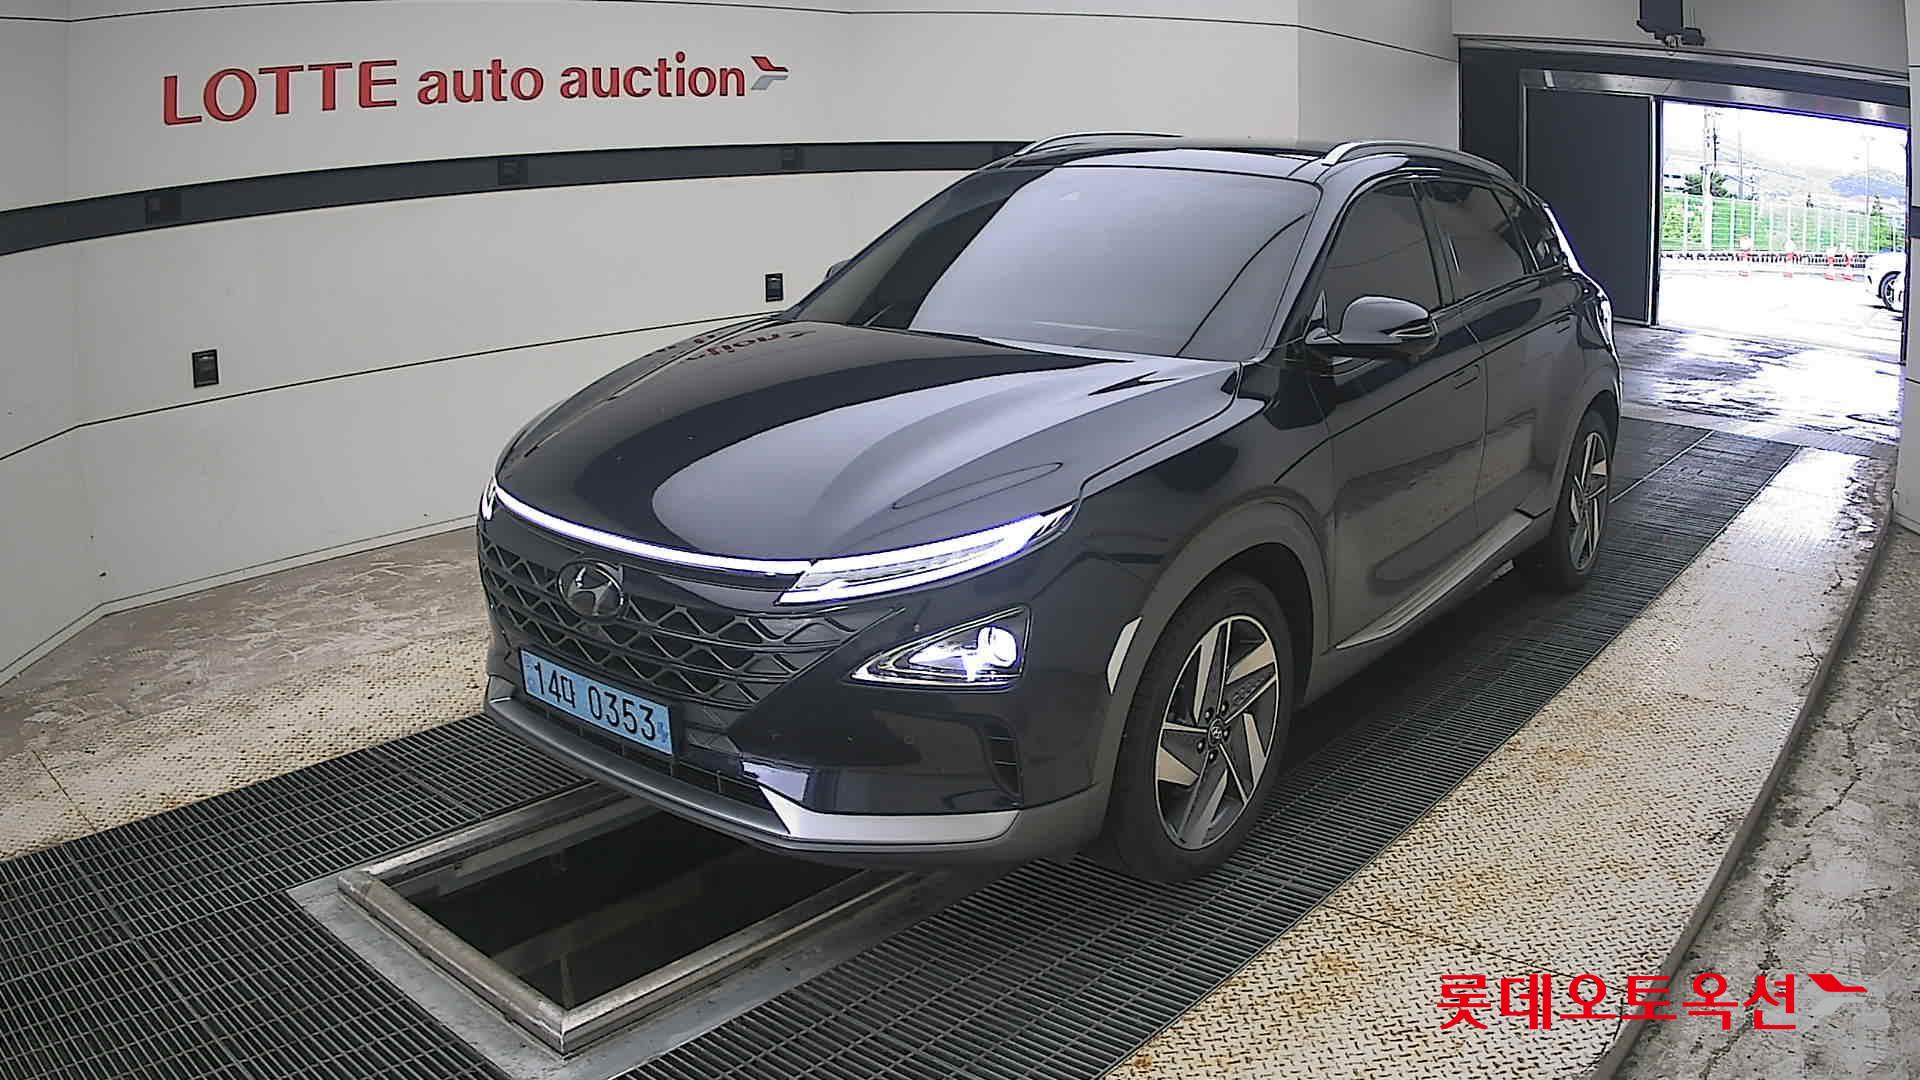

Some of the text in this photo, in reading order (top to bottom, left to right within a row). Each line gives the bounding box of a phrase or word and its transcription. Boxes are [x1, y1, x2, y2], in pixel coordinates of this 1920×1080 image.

[163, 51, 747, 126] LOTTE auto auction
[534, 661, 656, 741] 14마 0353
